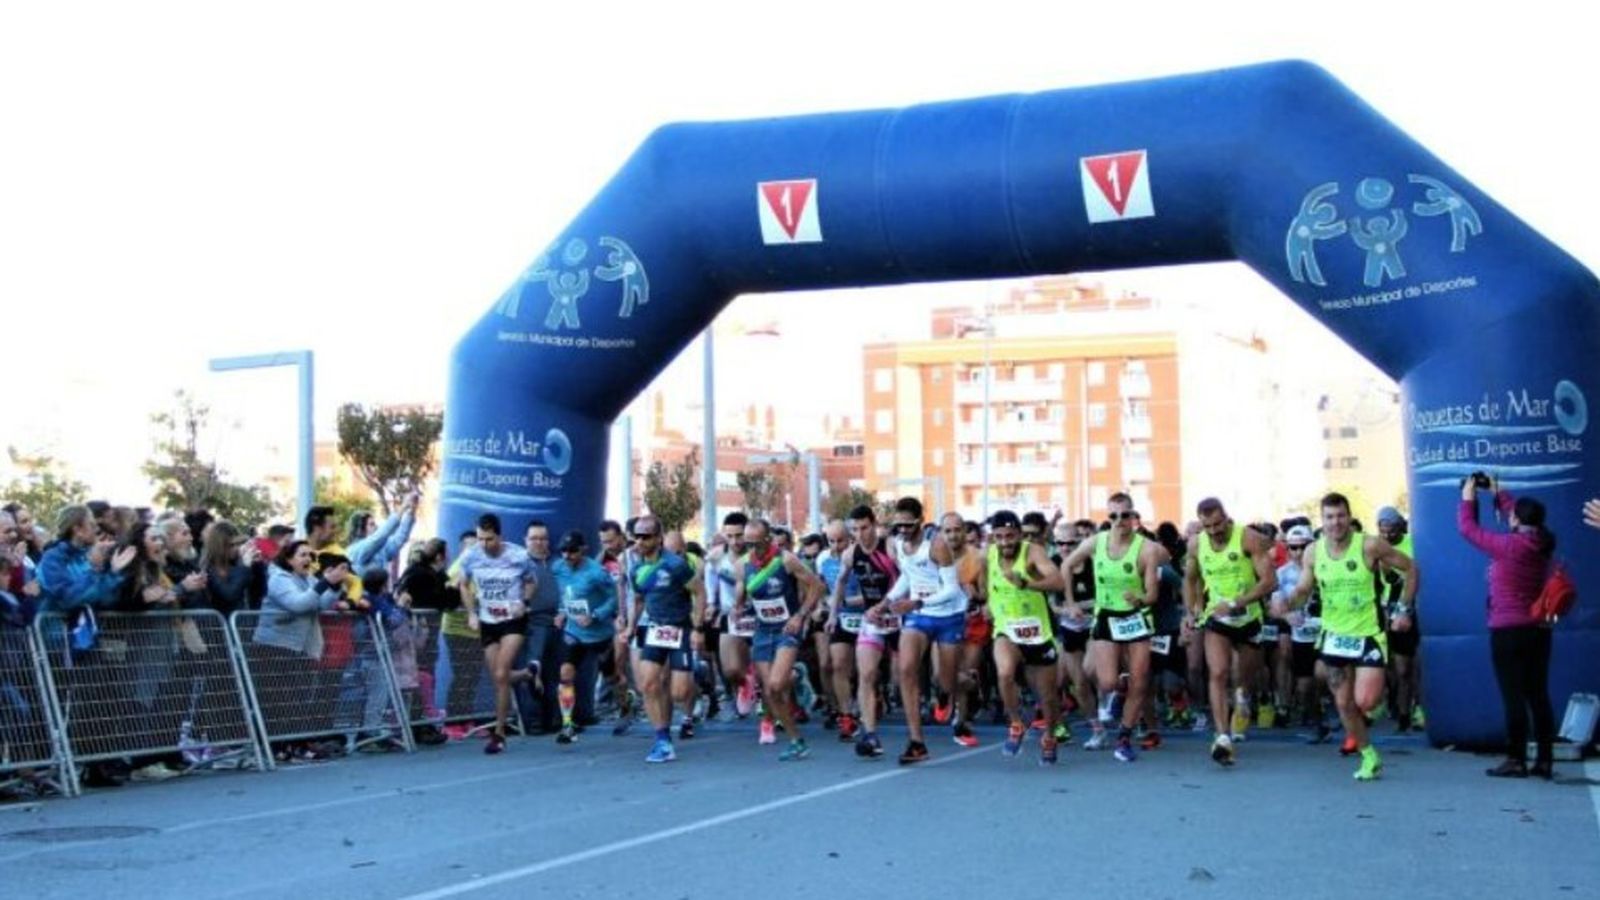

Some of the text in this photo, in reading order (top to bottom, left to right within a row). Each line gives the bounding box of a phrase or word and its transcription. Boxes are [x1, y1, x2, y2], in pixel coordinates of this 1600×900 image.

[1107, 160, 1122, 202] 1
[780, 186, 794, 226] 1
[1352, 287, 1402, 307] Municipal
[1404, 284, 1421, 299] de
[1422, 275, 1478, 294] Deportes
[528, 332, 574, 348] Municipal
[1478, 393, 1500, 422] de
[1506, 388, 1550, 422] Mar
[484, 430, 501, 454] de
[503, 430, 541, 457] Mar
[1447, 440, 1470, 461] del
[1474, 437, 1543, 459] Deporte
[1547, 432, 1583, 453] Base
[477, 467, 528, 488] Deporte
[532, 470, 563, 489] Base
